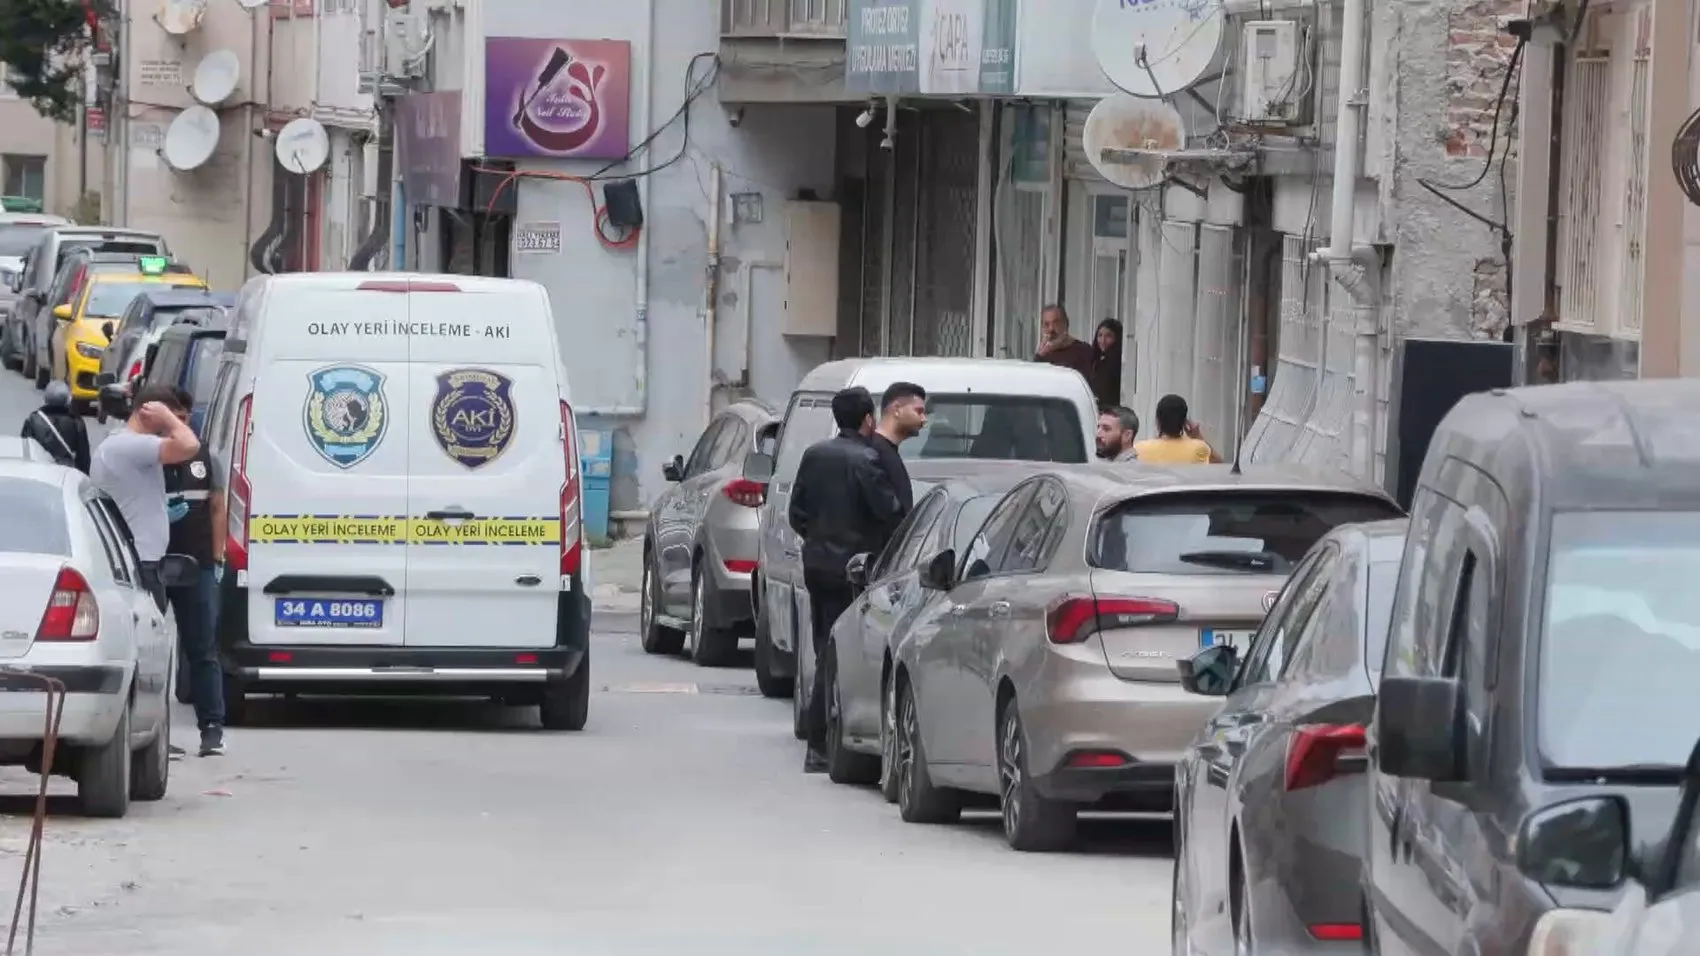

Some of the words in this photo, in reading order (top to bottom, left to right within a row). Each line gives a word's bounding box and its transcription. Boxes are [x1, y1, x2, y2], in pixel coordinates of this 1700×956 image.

[307, 323, 349, 335] OLAY
[354, 320, 388, 335] YERİ
[392, 320, 471, 337] İNCELEME
[484, 323, 510, 338] AKİ
[451, 408, 496, 427] AKİ
[262, 523, 298, 535] OLAY
[302, 520, 329, 535] YERİ
[333, 521, 396, 536] İNCELEME
[415, 525, 449, 537] OLAY
[454, 523, 481, 537] YERİ
[484, 523, 546, 537] İNCELEME
[283, 601, 305, 616] 34
[310, 602, 325, 617] A
[330, 602, 375, 617] 8086
